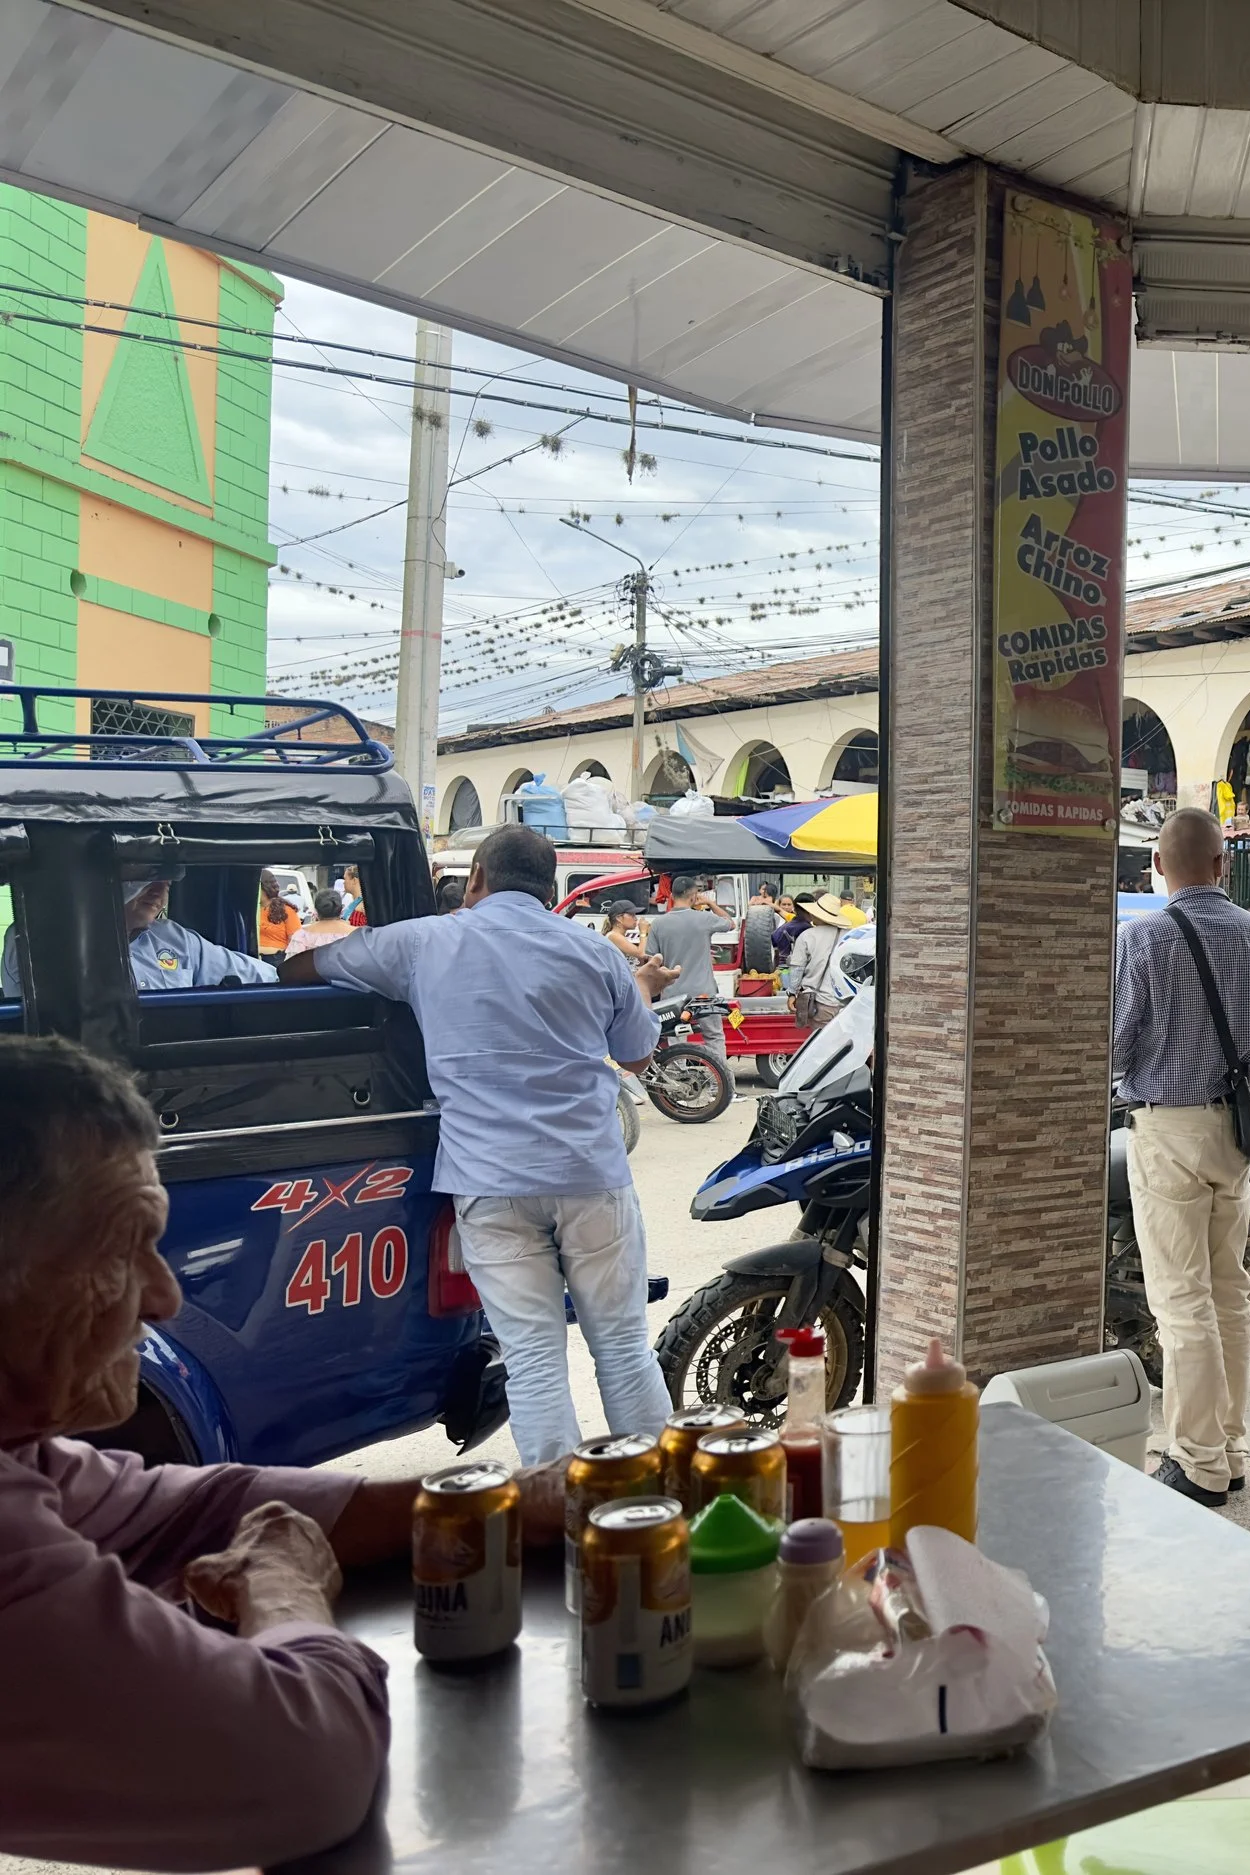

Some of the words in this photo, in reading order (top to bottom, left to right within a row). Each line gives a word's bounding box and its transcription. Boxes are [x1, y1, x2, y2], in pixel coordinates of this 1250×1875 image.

[1018, 357, 1055, 399] DON
[1058, 376, 1114, 415] POLLO
[1017, 427, 1099, 465] Pollo
[1018, 460, 1116, 501] Asado
[1020, 511, 1112, 580] Arroz
[1017, 543, 1103, 607] Chino
[998, 615, 1108, 657] COMIDAS
[1007, 647, 1108, 686] Rapidas
[1004, 800, 1054, 817] COMIDAS
[1057, 806, 1103, 821] RAPIDAS
[285, 1225, 408, 1315] 410
